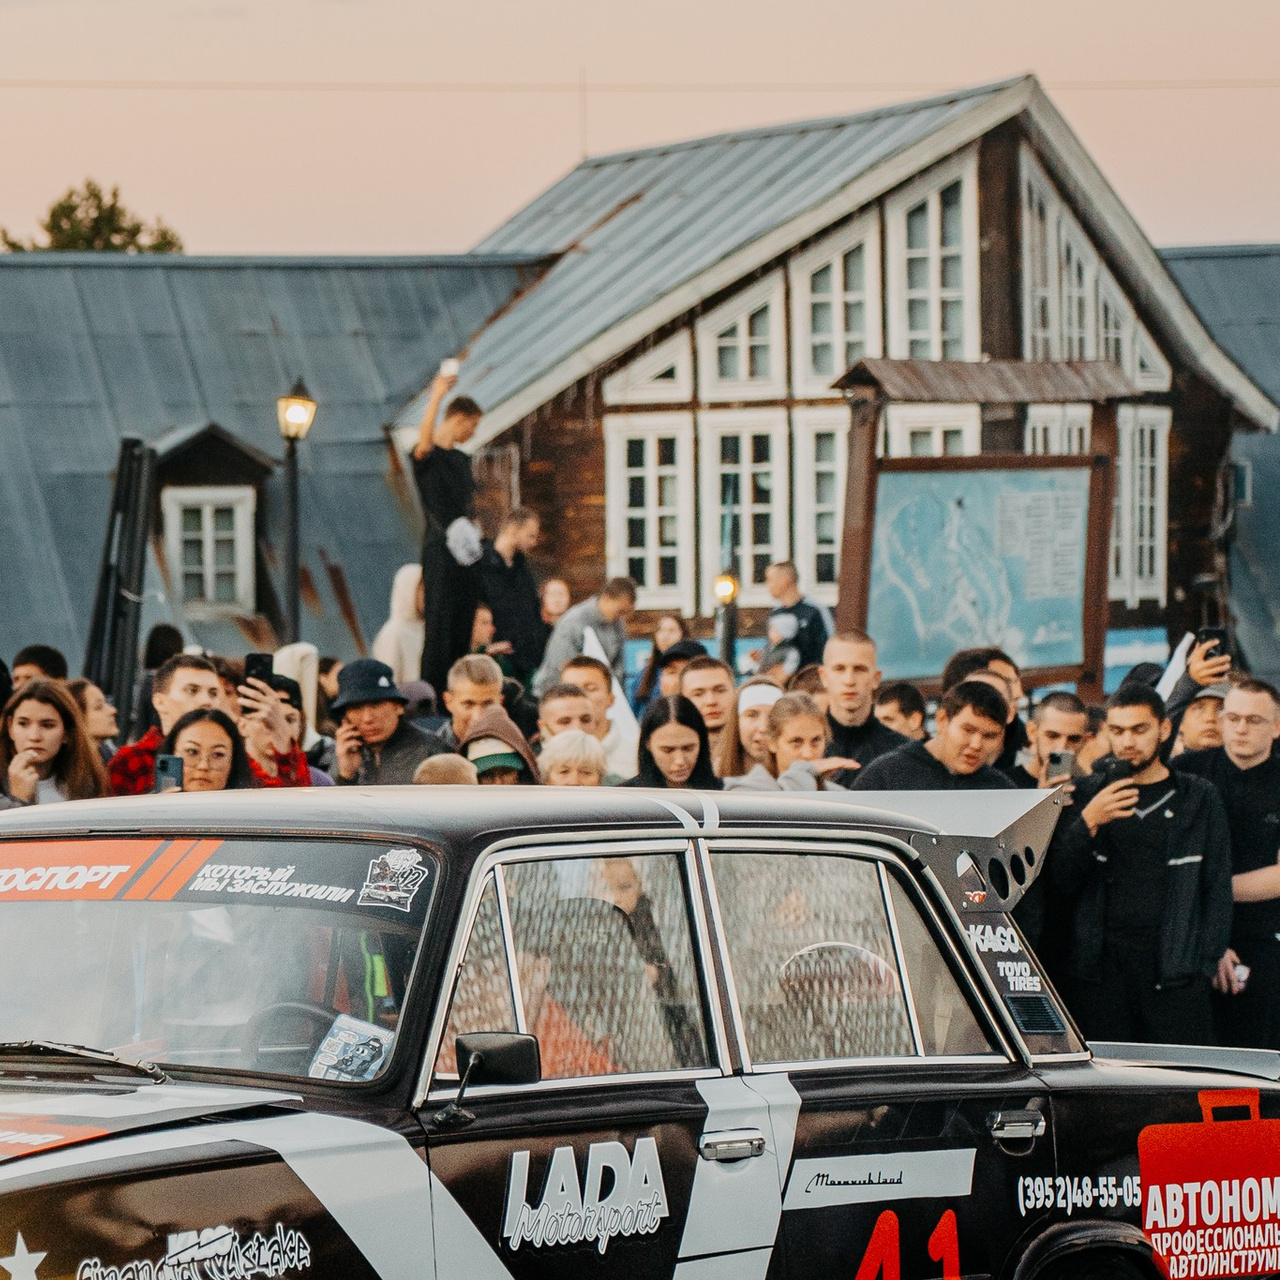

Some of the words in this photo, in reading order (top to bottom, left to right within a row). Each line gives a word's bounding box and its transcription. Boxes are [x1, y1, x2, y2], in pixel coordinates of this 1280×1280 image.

[196, 864, 296, 882] КОТОРЫЙ
[188, 877, 228, 892] МЫ
[226, 879, 356, 903] ЗАСЛУЖИЛИ
[997, 961, 1031, 977] TOYO
[1007, 976, 1042, 991] TIRES
[503, 1137, 670, 1238] LADA
[508, 1190, 662, 1255] Motorsport
